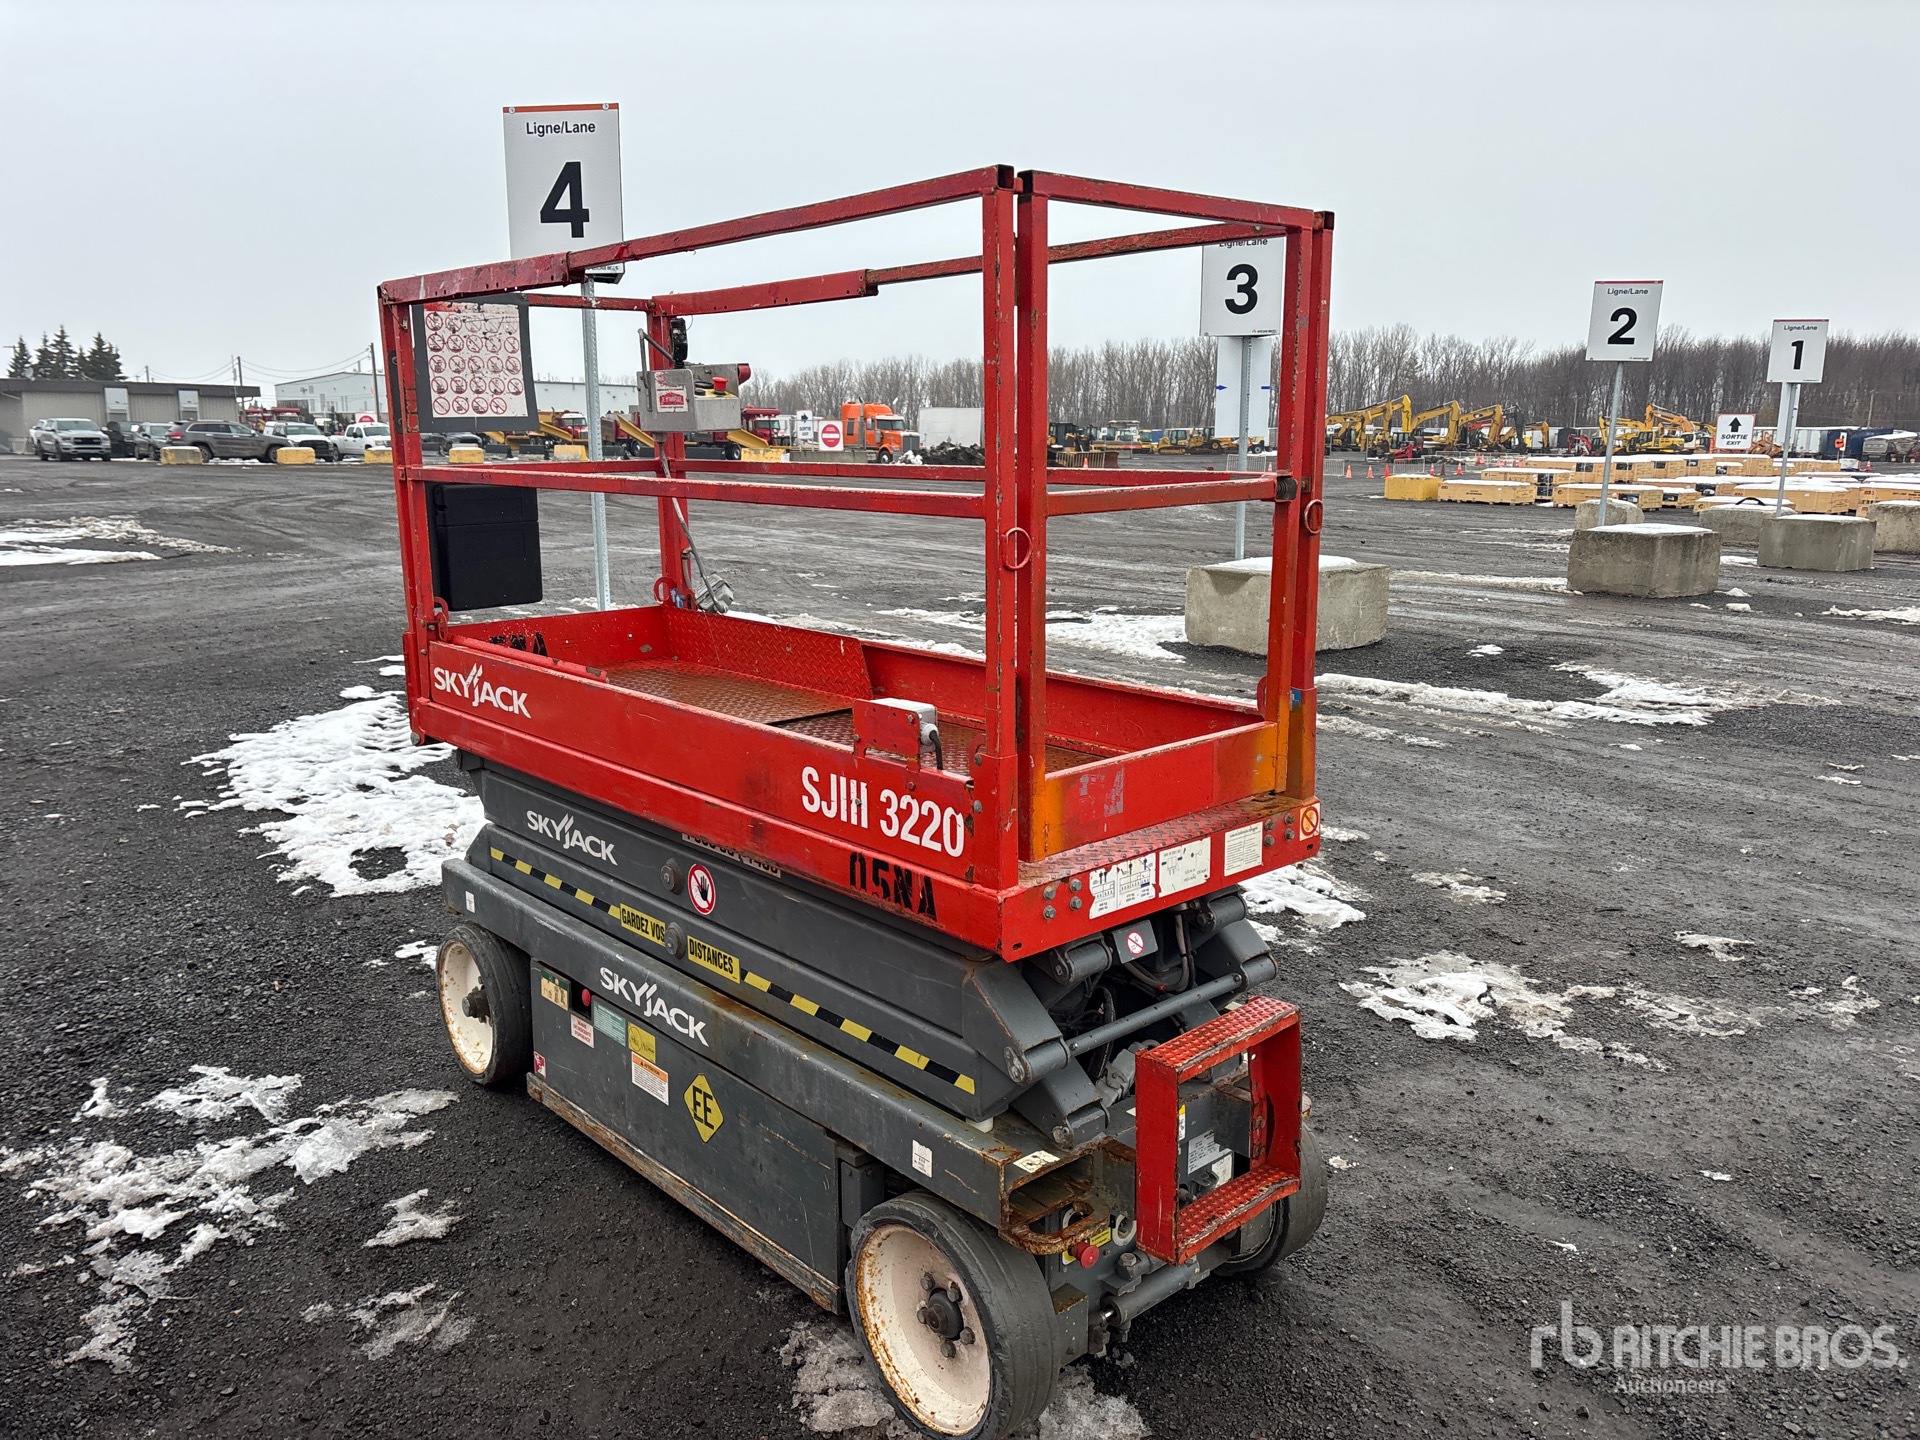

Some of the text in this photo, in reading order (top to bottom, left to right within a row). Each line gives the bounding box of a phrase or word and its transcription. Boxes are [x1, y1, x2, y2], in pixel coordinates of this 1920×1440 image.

[526, 121, 596, 137] Ligne/Lane
[540, 161, 590, 238] 4
[1225, 263, 1259, 315] 3
[1607, 287, 1649, 296] Ligne/Lane
[1607, 307, 1638, 345] 2
[1791, 340, 1805, 370] 1
[433, 662, 531, 718] SKYJACK
[526, 810, 618, 866] SKYJACK
[879, 788, 965, 858] 3220
[621, 907, 734, 975] GARDEZ VOS DISTANCES
[599, 965, 710, 1048] SKYJACK
[692, 1084, 715, 1130] EE
